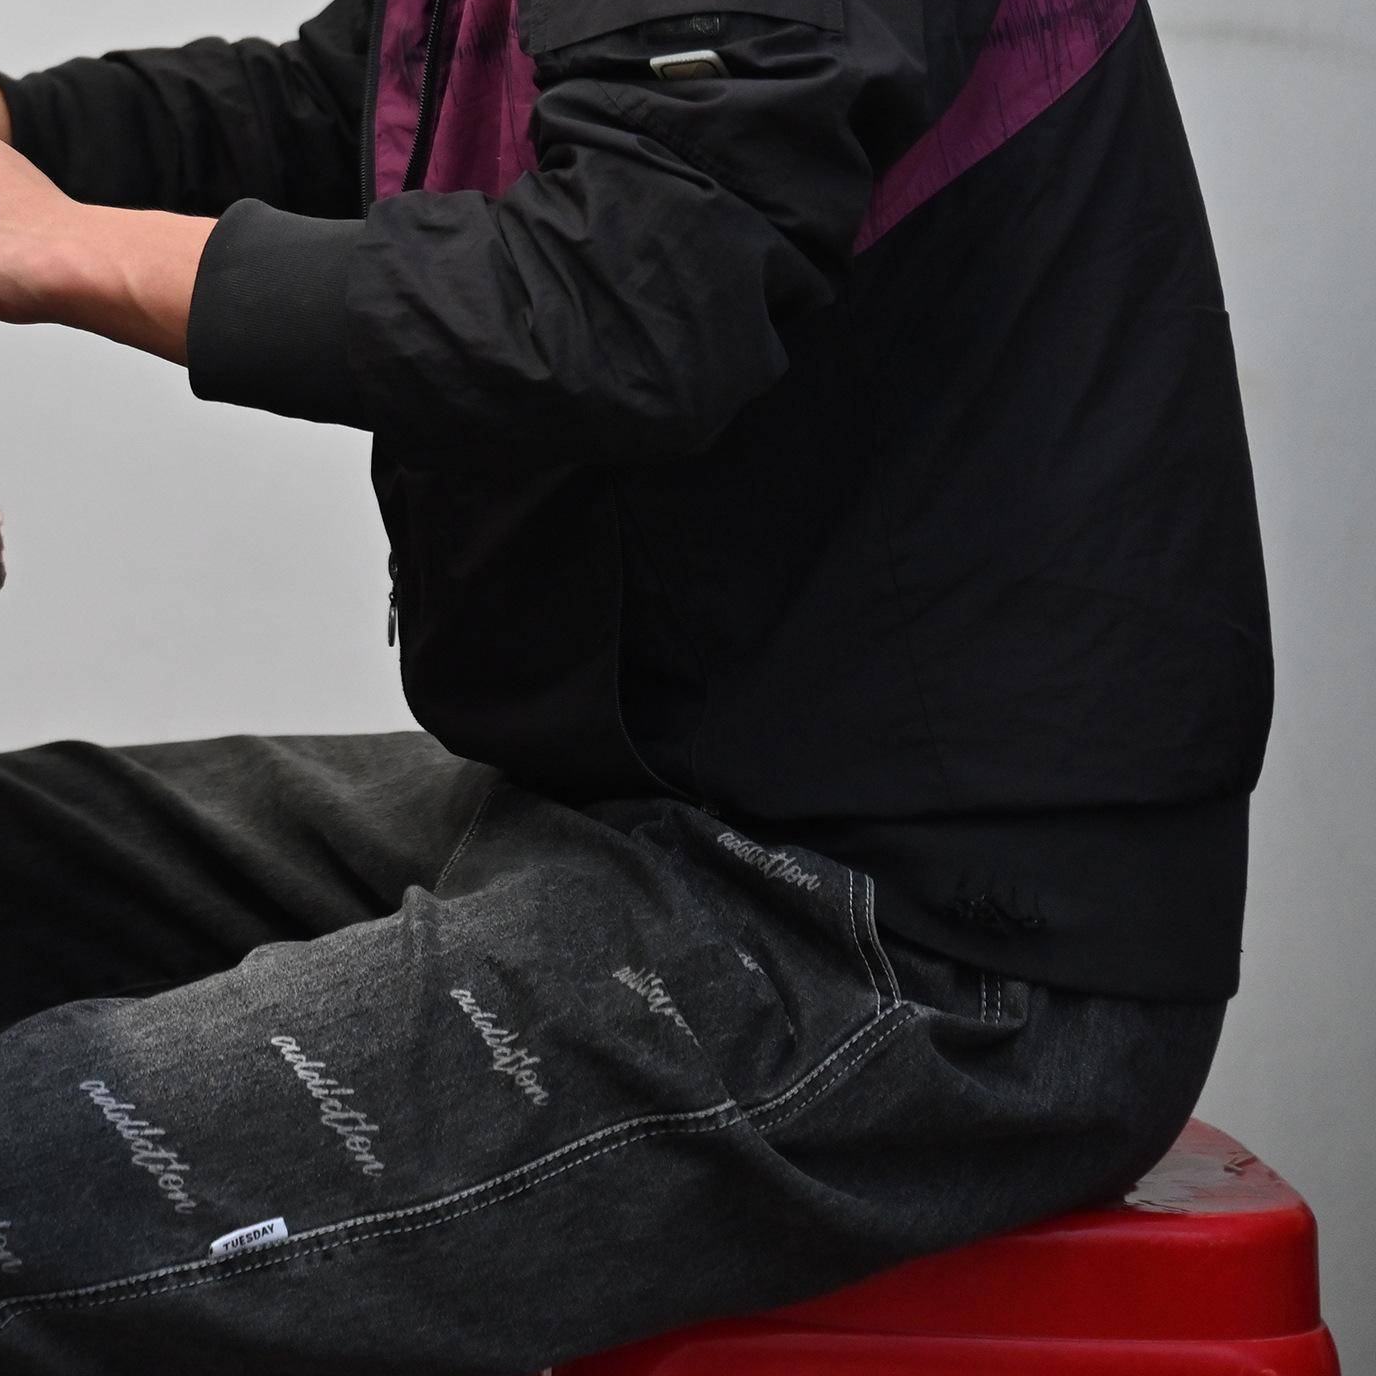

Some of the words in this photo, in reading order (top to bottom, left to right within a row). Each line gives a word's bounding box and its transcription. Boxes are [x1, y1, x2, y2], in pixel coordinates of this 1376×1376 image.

[271, 1035, 384, 1177] addiction
[450, 989, 549, 1105] addiction
[79, 1080, 196, 1214] addiction
[223, 1224, 274, 1251] TUESDAY
